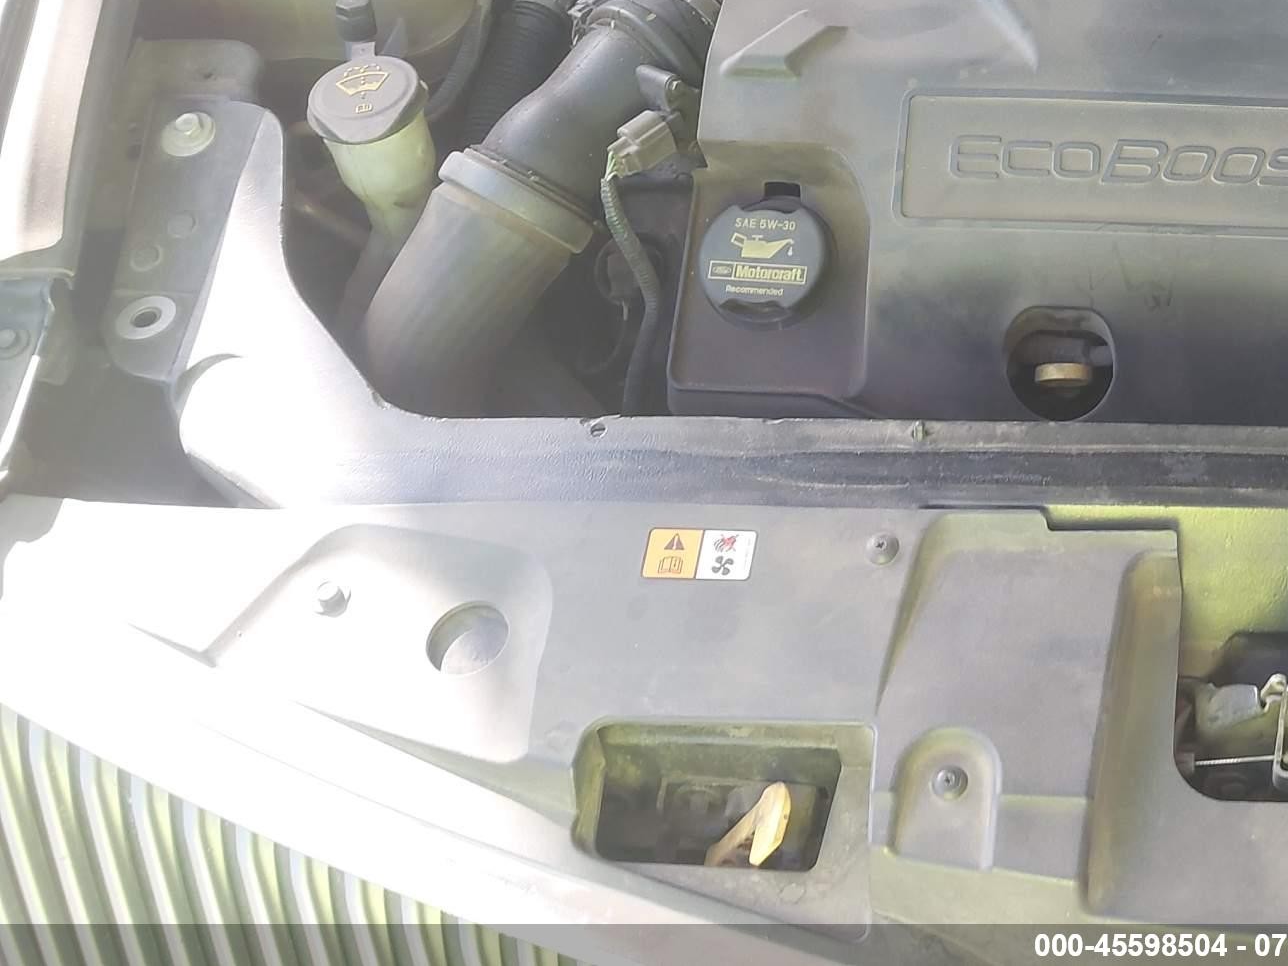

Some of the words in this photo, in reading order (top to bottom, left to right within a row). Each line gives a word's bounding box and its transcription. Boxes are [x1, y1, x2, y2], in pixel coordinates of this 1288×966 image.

[735, 217, 757, 228] SAE
[759, 218, 796, 231] 5W-30
[725, 284, 784, 297] Recommended
